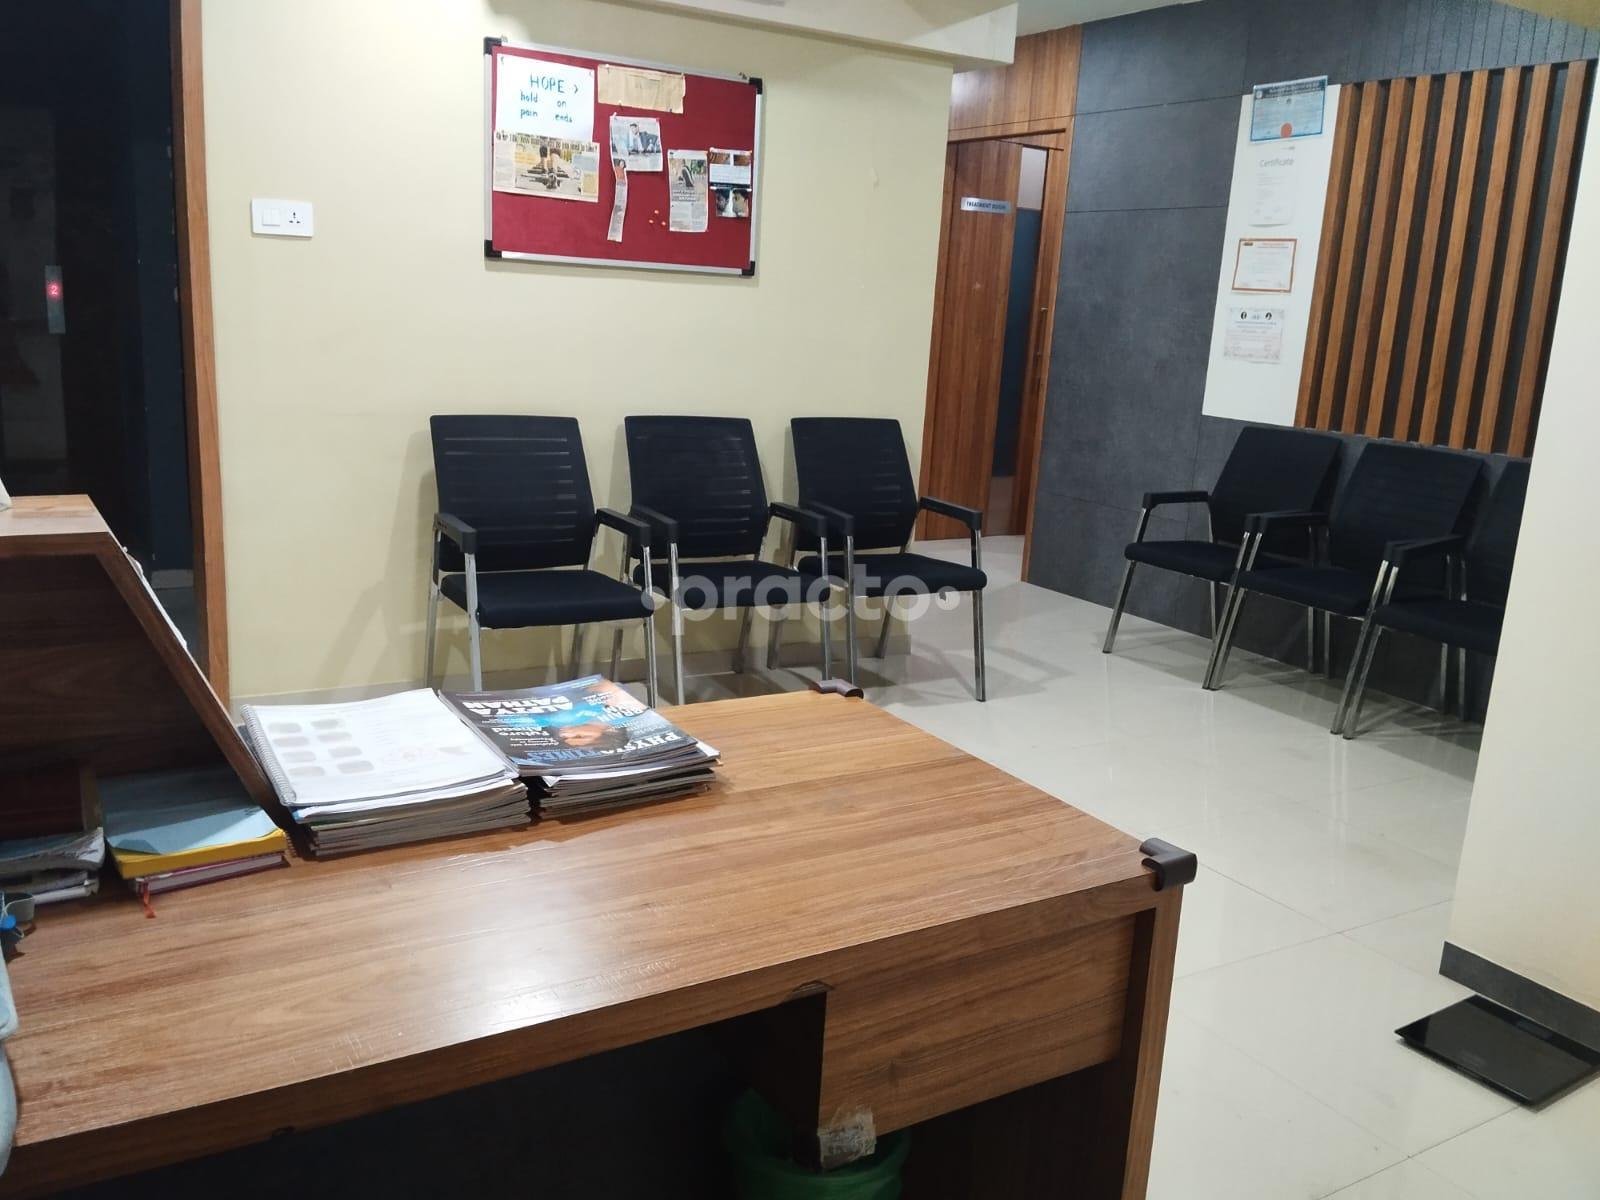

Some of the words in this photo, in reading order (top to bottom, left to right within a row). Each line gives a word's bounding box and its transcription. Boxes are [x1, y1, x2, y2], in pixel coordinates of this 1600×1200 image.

[530, 74, 565, 93] HOPE
[520, 90, 538, 103] hold
[556, 100, 567, 108] on
[520, 108, 538, 120] pain
[1260, 158, 1294, 168] Certificate
[462, 696, 570, 709] PATHAN
